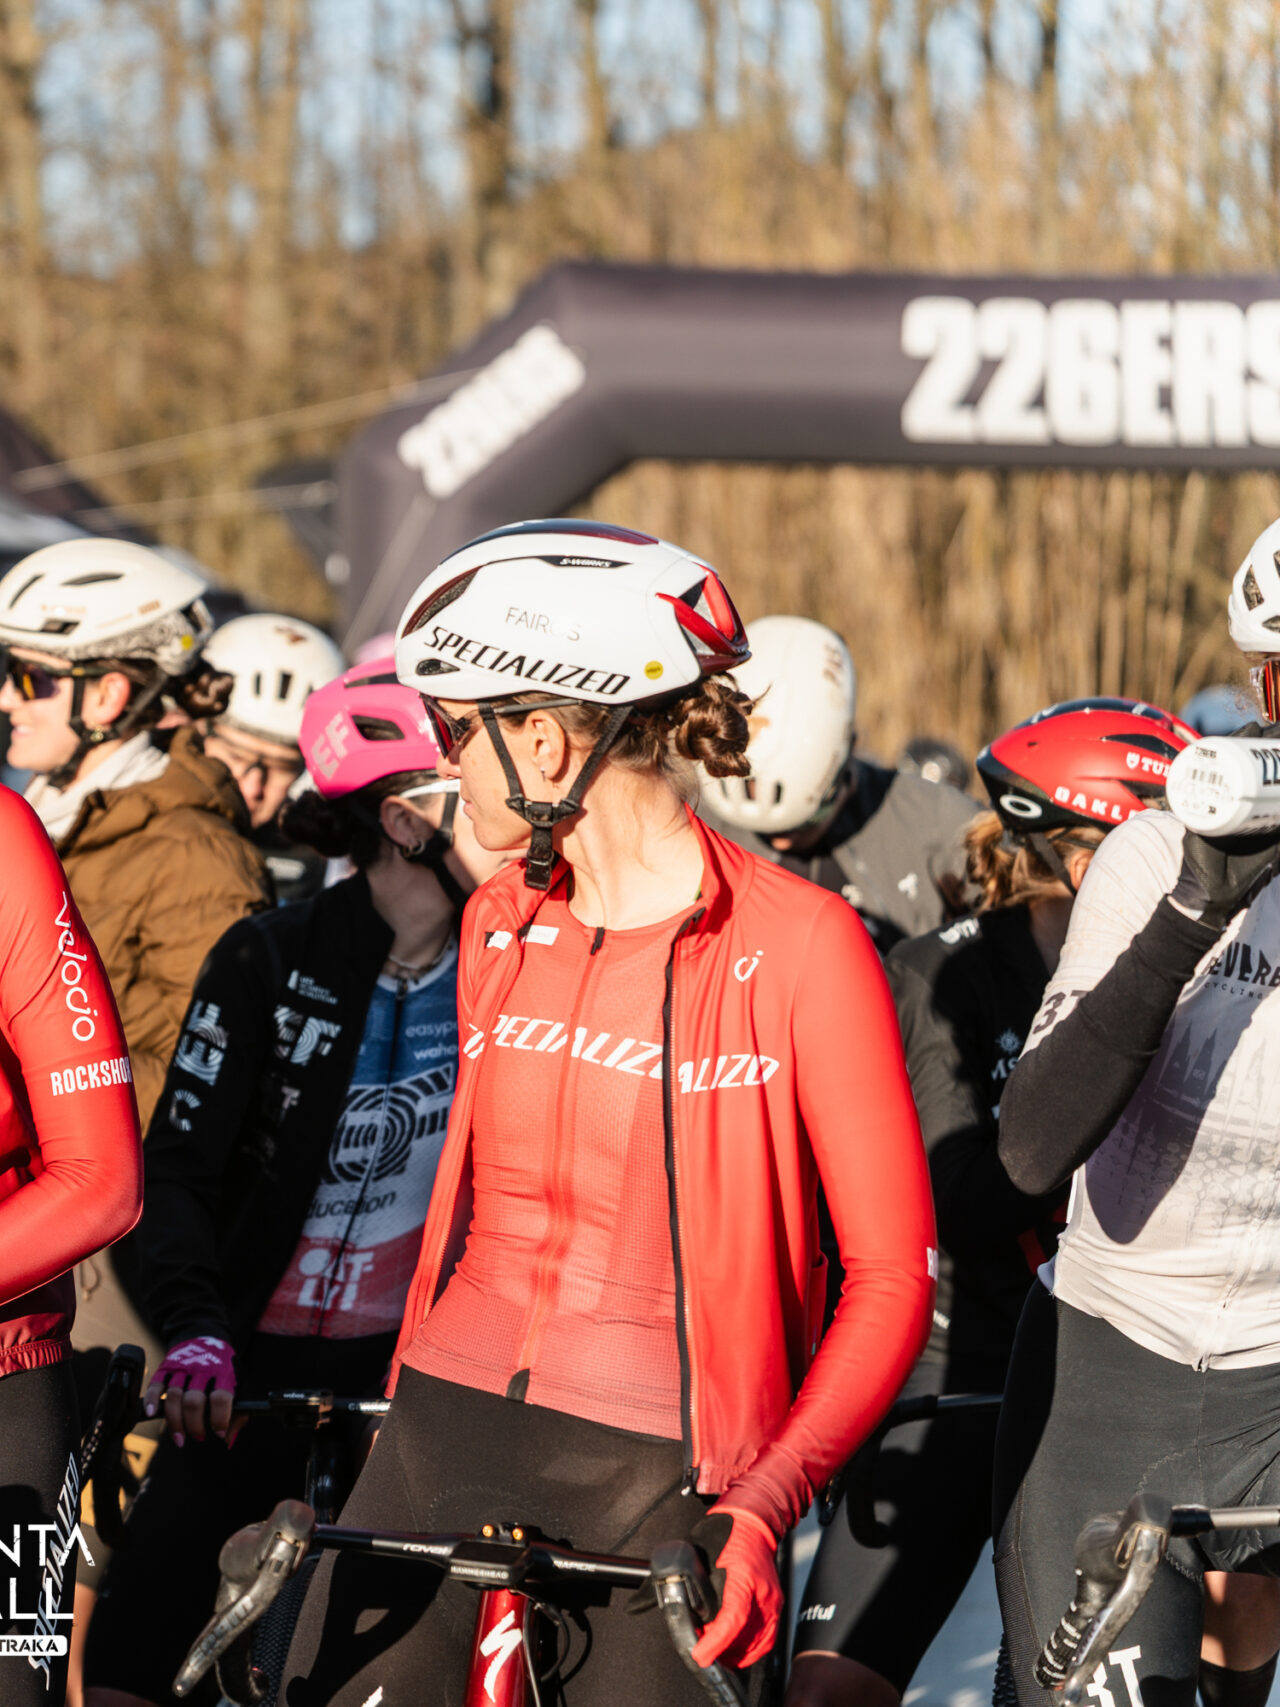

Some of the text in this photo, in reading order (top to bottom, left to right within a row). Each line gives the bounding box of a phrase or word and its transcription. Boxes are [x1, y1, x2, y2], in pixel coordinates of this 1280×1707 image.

[505, 606, 581, 642] FAIRS
[424, 625, 632, 696] SPECIALIZED
[54, 891, 98, 1042] velocio
[1204, 982, 1263, 1000] CYCLING
[450, 1565, 509, 1580] HAMMERHEAD
